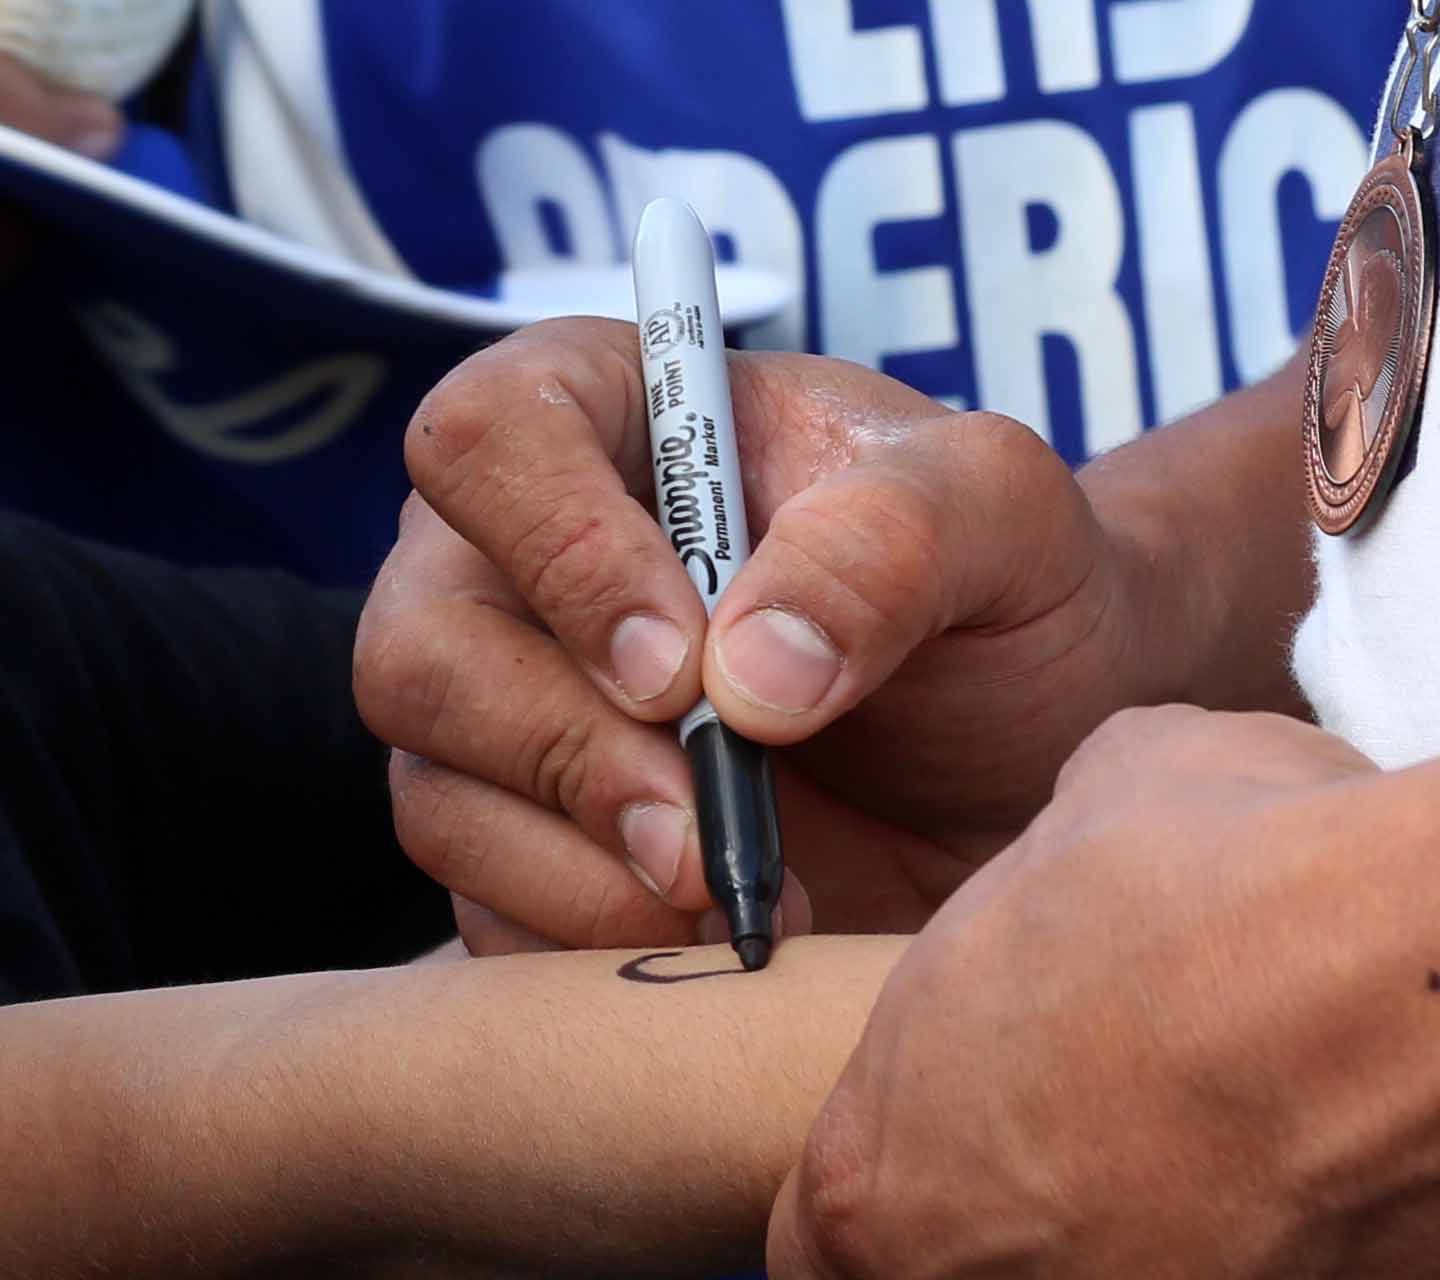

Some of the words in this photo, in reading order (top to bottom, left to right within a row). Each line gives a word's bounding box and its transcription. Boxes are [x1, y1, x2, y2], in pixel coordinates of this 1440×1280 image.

[651, 377, 667, 419] FINE
[663, 358, 687, 408] POINT
[701, 415, 720, 468] Marker
[711, 480, 732, 561] Permanent
